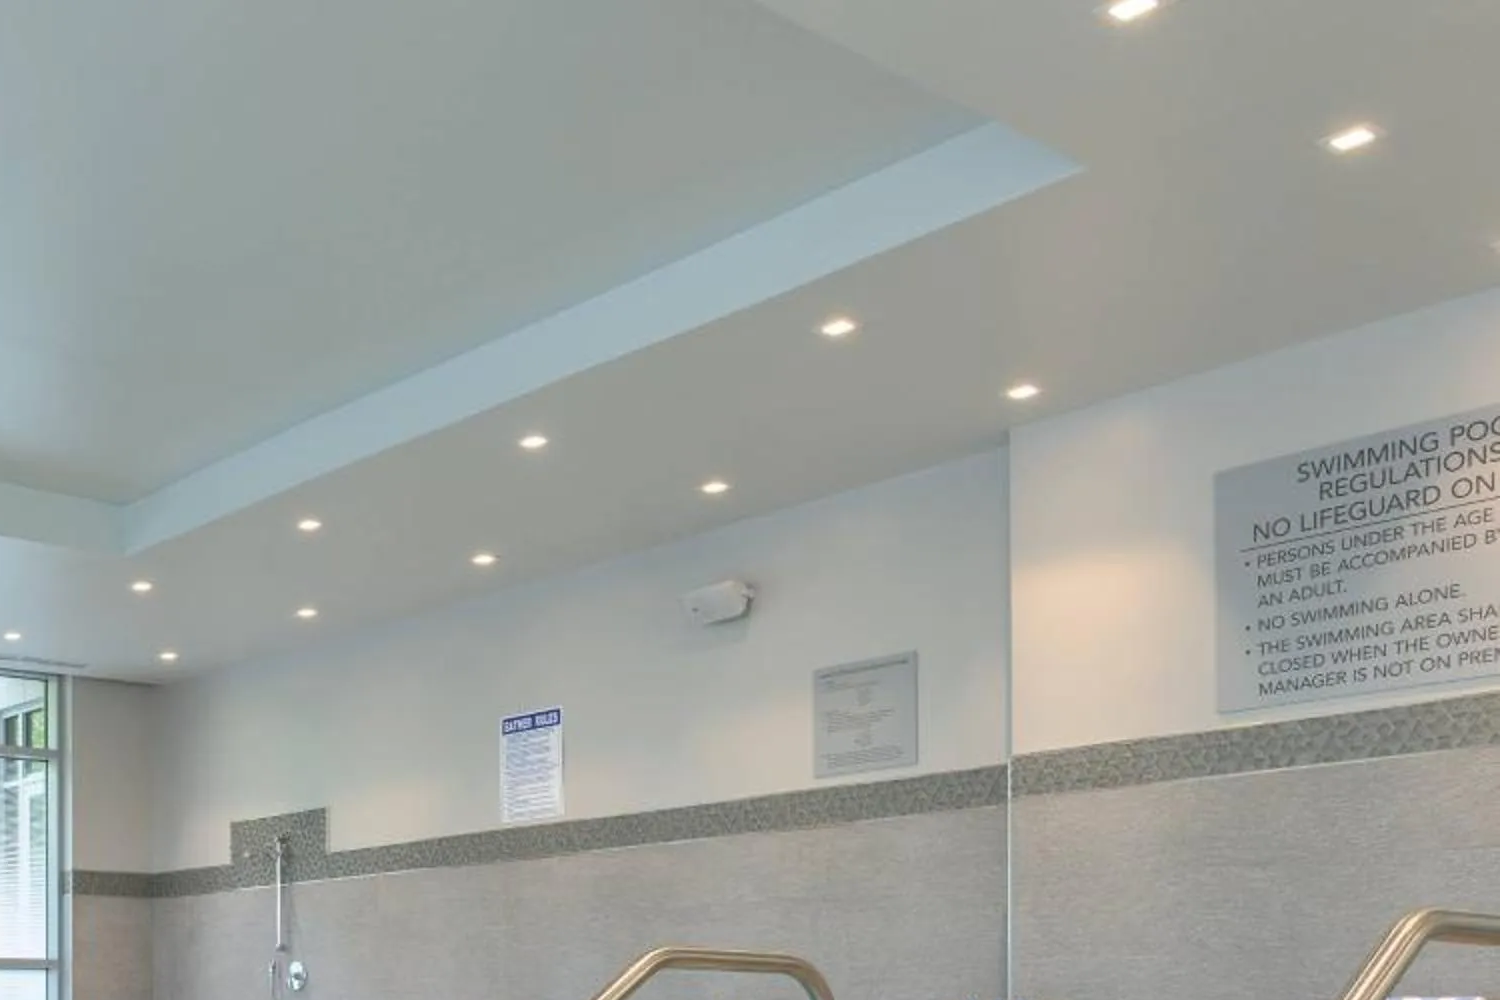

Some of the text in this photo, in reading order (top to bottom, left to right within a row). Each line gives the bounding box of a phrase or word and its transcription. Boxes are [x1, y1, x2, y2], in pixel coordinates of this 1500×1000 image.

[1297, 431, 1439, 483] SWIMMING
[1319, 441, 1500, 500] REGULATIONS
[1253, 472, 1495, 542] NO LIFEGUARD ON
[1257, 508, 1493, 568] PERSONS UNDER THE AGE
[1257, 567, 1302, 588] MUST
[1311, 561, 1331, 578] BE
[1337, 533, 1476, 573] ACCOMPANIED
[1257, 579, 1348, 608] AN ADULT.
[1258, 615, 1286, 631] NO
[1290, 597, 1389, 627] SWIMMING
[1257, 638, 1291, 656] THE
[1295, 620, 1395, 650] SWIMMING
[1400, 612, 1453, 634] AREA
[1257, 653, 1326, 676] CLOSED
[1331, 643, 1387, 665] WHEN
[1394, 635, 1430, 655] THE
[1258, 671, 1347, 697] MANAGER
[1353, 667, 1368, 682] IS
[1373, 659, 1414, 679] NOT
[1420, 654, 1452, 673] ON
